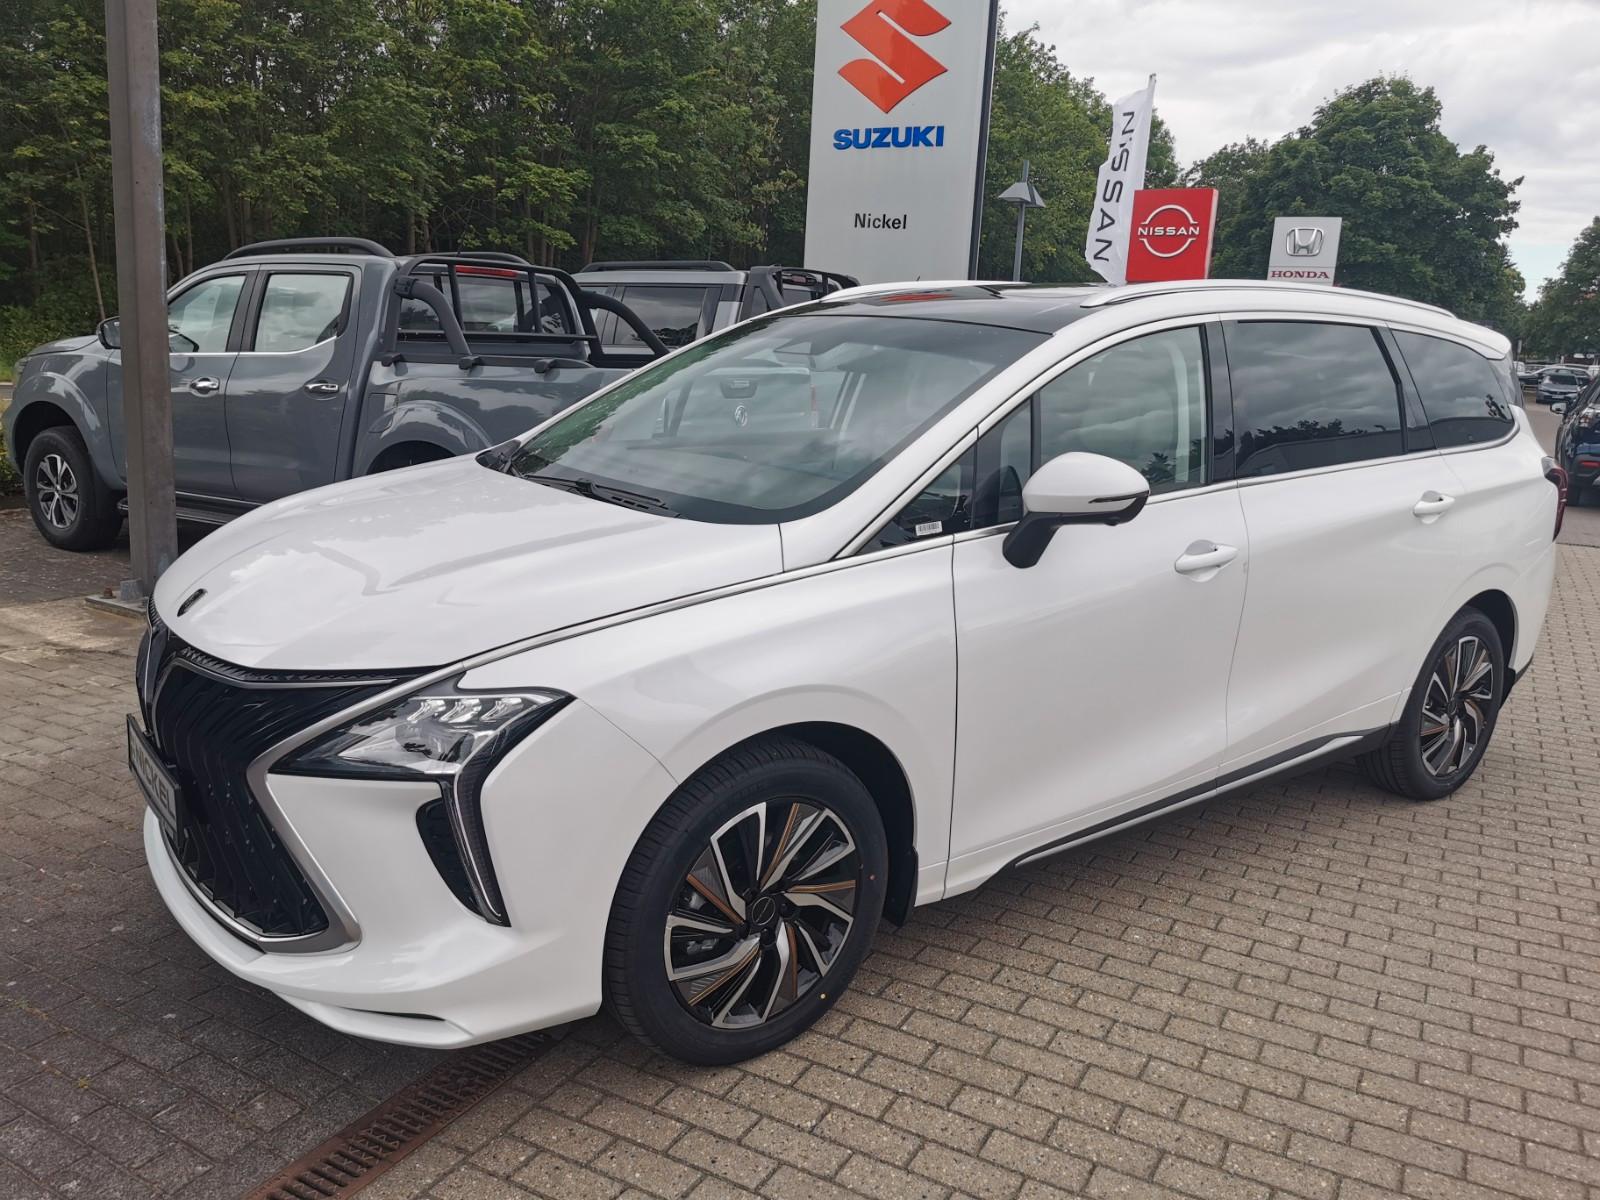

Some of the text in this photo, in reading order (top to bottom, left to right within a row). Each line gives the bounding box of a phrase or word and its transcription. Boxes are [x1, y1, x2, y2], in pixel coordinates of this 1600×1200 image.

[833, 125, 945, 151] SUZUKI
[854, 213, 907, 230] Nickel
[1137, 226, 1200, 236] NISSAN
[1271, 270, 1330, 279] HONDA
